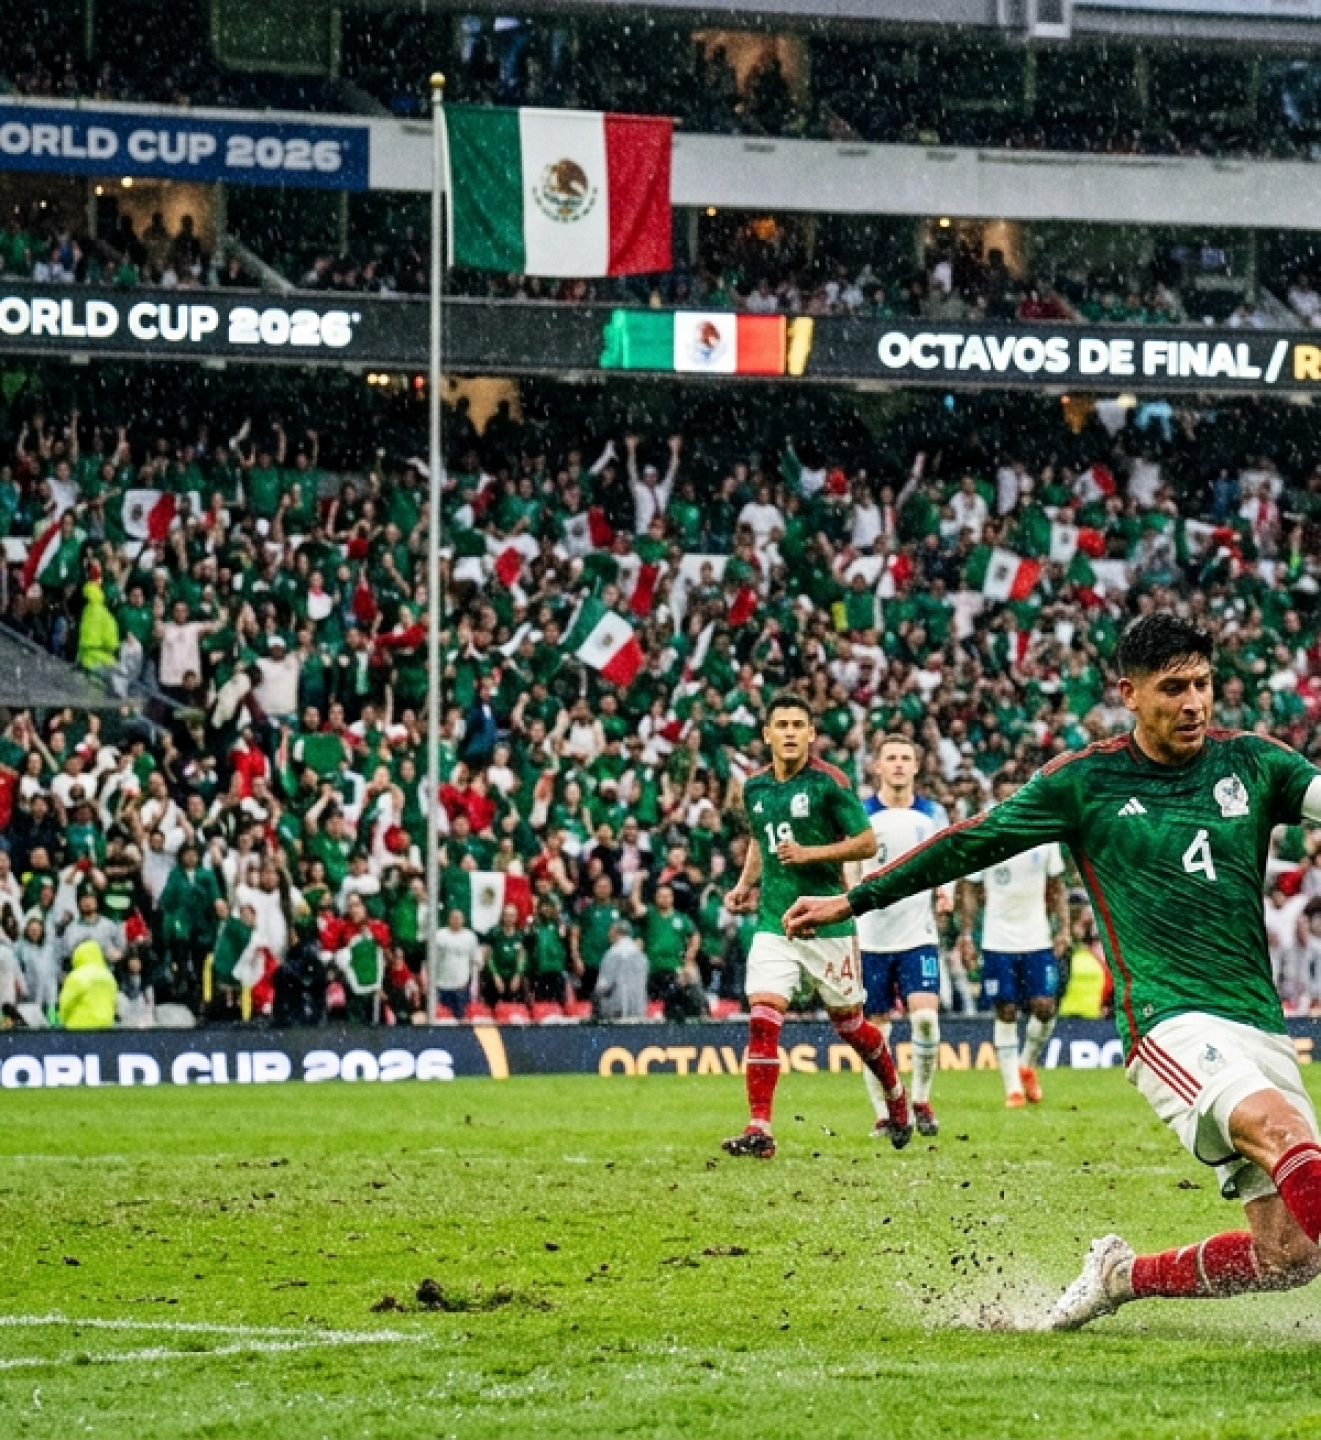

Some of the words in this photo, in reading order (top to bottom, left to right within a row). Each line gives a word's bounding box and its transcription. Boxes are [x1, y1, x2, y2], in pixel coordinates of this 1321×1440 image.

[0, 122, 119, 160] ORLD
[127, 129, 217, 165] CUP
[224, 134, 342, 173] 2026
[0, 296, 120, 338] ORLD
[127, 301, 219, 342] CUP
[228, 306, 354, 348] 2026
[877, 331, 1071, 374] OCTAVOS
[1078, 337, 1136, 375] DE
[1142, 340, 1262, 379] FINAL
[1182, 829, 1218, 881] 4
[302, 1047, 455, 1083] 2026
[598, 1043, 818, 1077] OCTAVS
